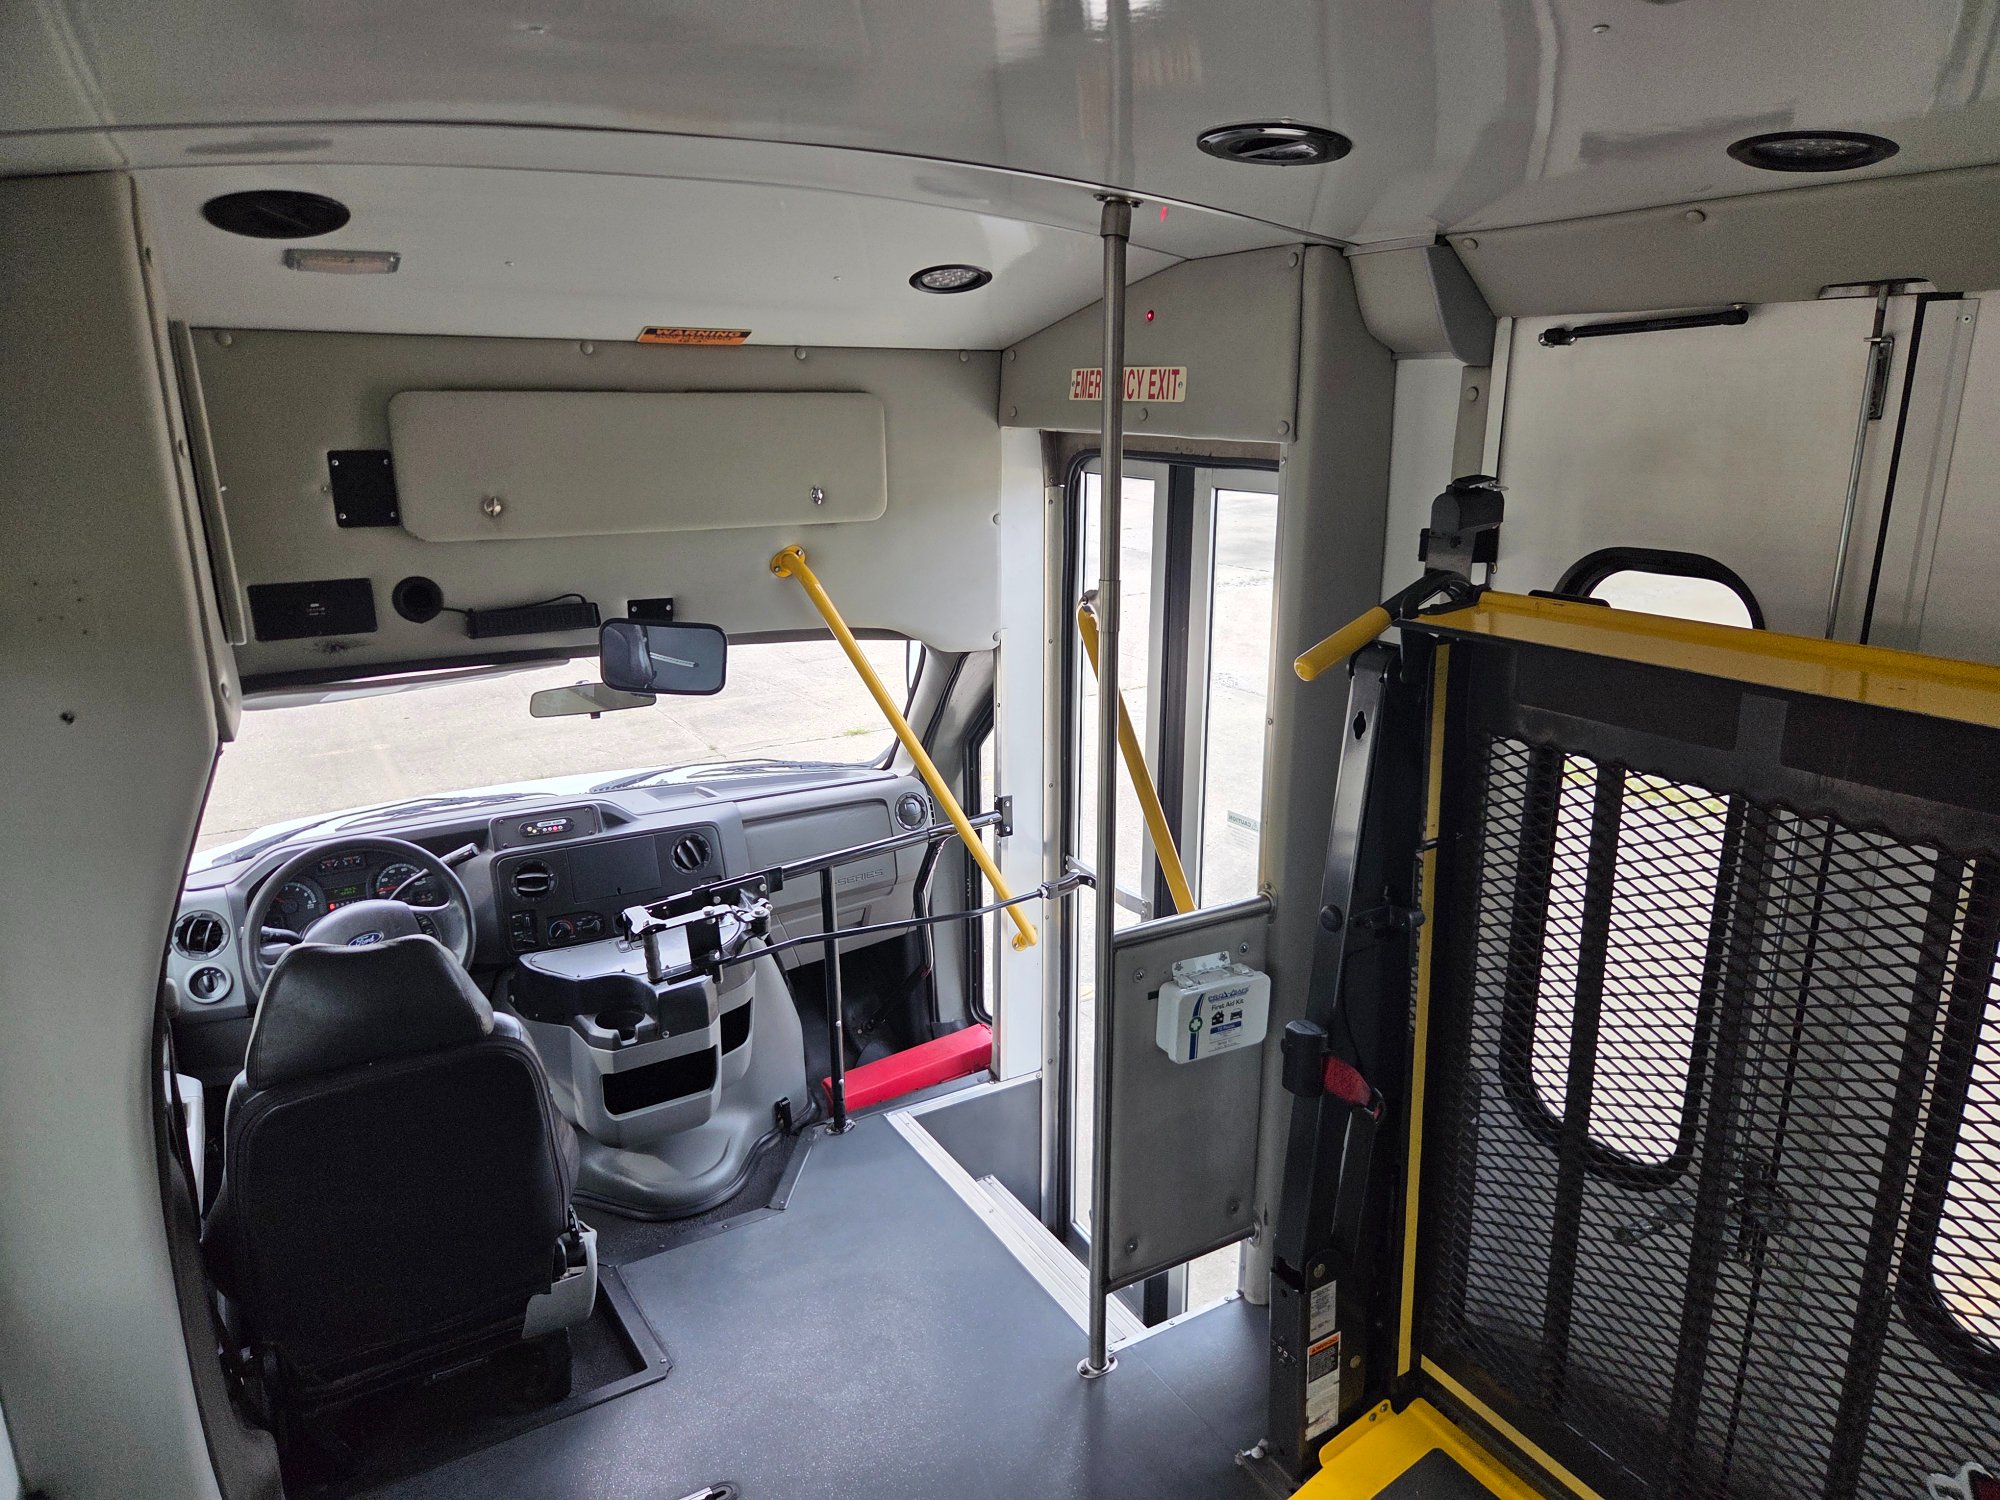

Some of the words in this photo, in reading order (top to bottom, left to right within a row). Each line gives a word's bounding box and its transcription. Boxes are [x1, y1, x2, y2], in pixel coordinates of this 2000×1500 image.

[656, 329, 741, 337] WARNING
[1074, 369, 1145, 400] EMERCY
[1148, 369, 1180, 400] EXIT
[1211, 1003, 1225, 1011] First
[1226, 1000, 1235, 1008] Aid
